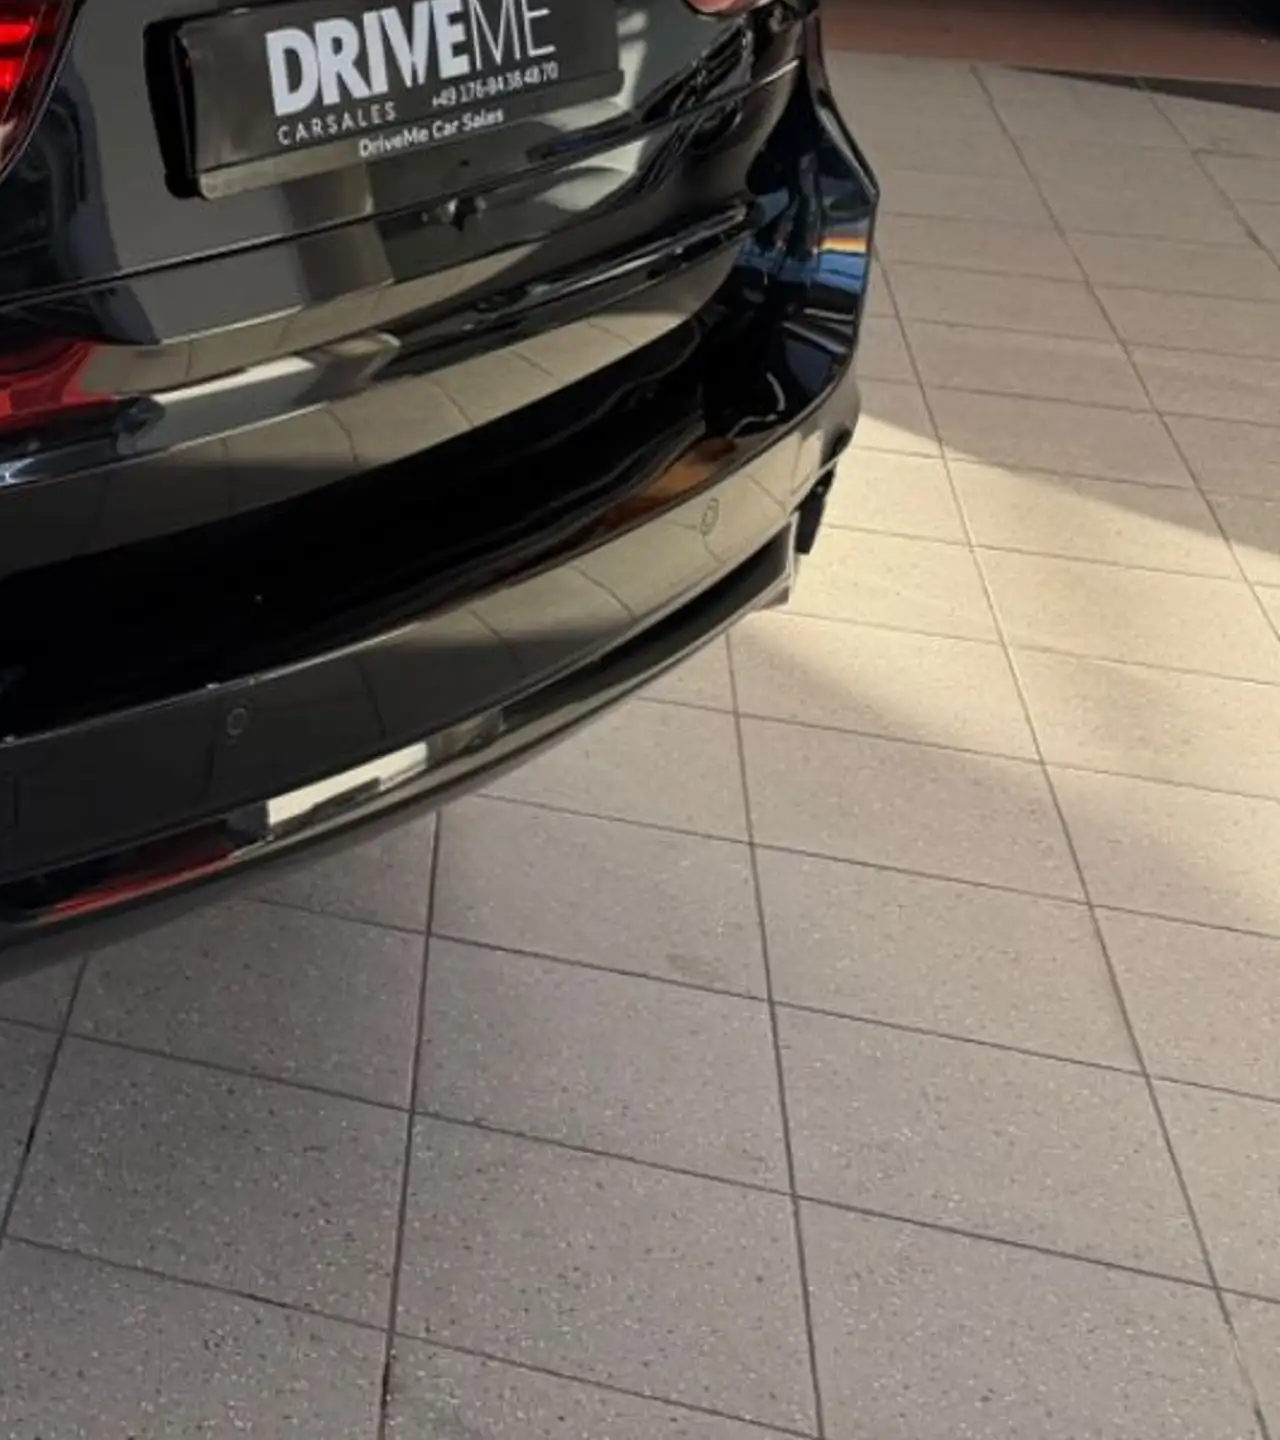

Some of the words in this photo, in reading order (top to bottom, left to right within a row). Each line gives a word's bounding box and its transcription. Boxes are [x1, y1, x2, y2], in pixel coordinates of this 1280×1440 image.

[277, 101, 397, 146] CARSALES
[358, 125, 430, 158] DriveMe
[432, 117, 459, 139] Car
[461, 108, 505, 132] Sales
